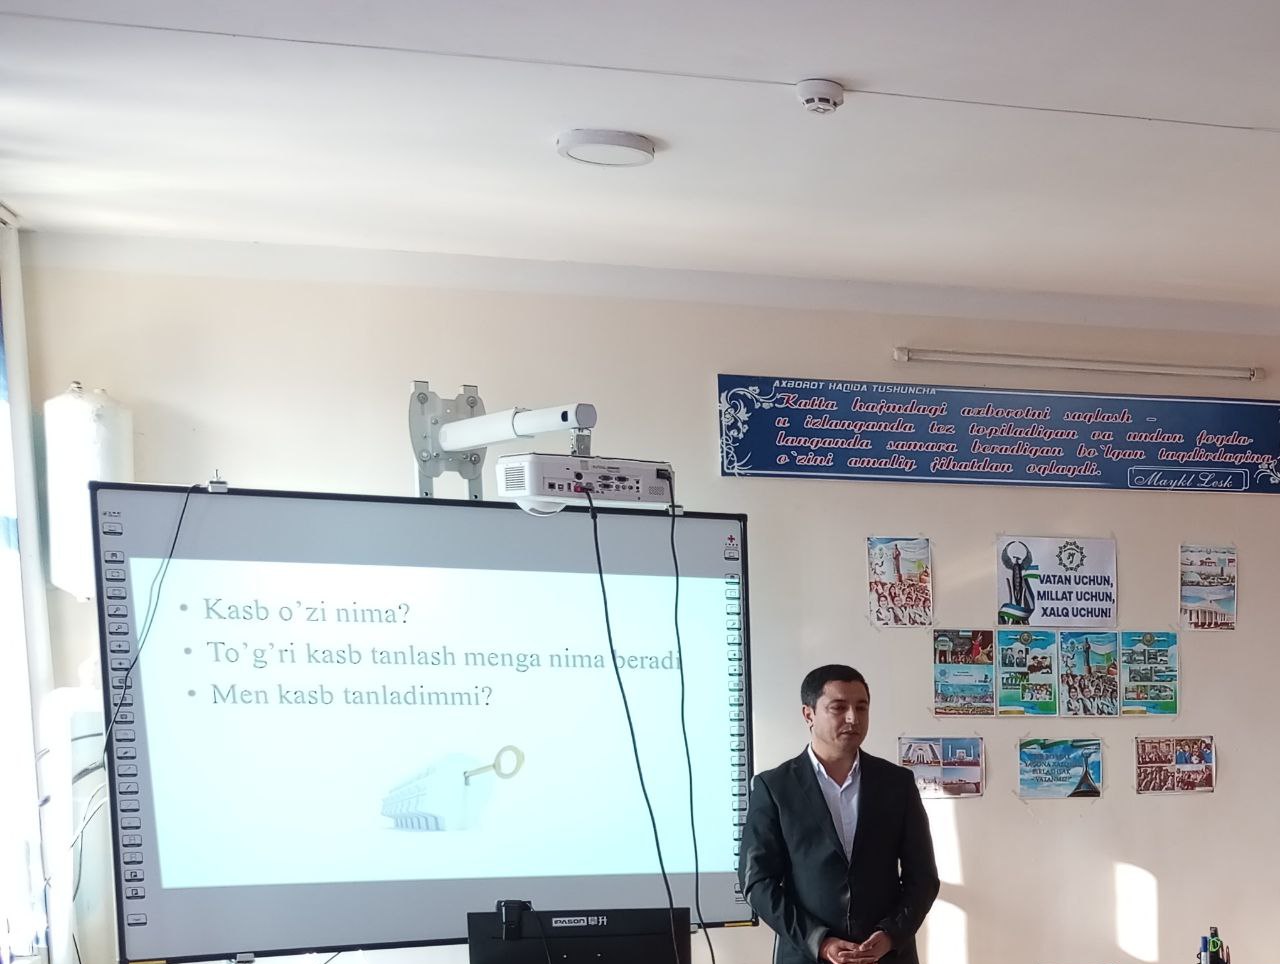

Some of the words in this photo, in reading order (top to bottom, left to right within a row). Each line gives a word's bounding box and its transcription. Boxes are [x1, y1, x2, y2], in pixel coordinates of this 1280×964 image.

[773, 379, 825, 389] AXBOROT
[828, 382, 868, 393] HAQIDA
[872, 384, 936, 395] TUSHUNCHA
[775, 393, 838, 410] Katta
[851, 397, 947, 416] hajmdagi
[960, 403, 1051, 420] axborotni
[1063, 408, 1132, 424] saqlash
[803, 415, 915, 433] izlanganda
[928, 421, 955, 434] tez
[968, 422, 1078, 440] topiladigan
[1126, 428, 1184, 443] undan
[775, 431, 872, 449] langanda
[886, 440, 958, 453] samara
[847, 454, 917, 471] amaliy
[930, 456, 1014, 473] jihatdan
[1134, 471, 1193, 490] Maykl
[1039, 574, 1072, 585] VATAN
[1074, 575, 1114, 588] UCHUN,
[1037, 590, 1073, 601] MILLAT
[1075, 591, 1115, 604] UCHUN,
[203, 598, 269, 621] Kasb
[336, 601, 411, 624] nima?
[1041, 606, 1070, 618] XALQ
[1071, 607, 1112, 618] UCHUN!
[306, 643, 362, 665] kasb
[371, 645, 457, 666] tanlash
[464, 650, 542, 673] menga
[549, 647, 606, 669] nima
[211, 683, 270, 705] Men
[277, 683, 334, 705] kasb
[343, 685, 493, 706] tanladimmi?
